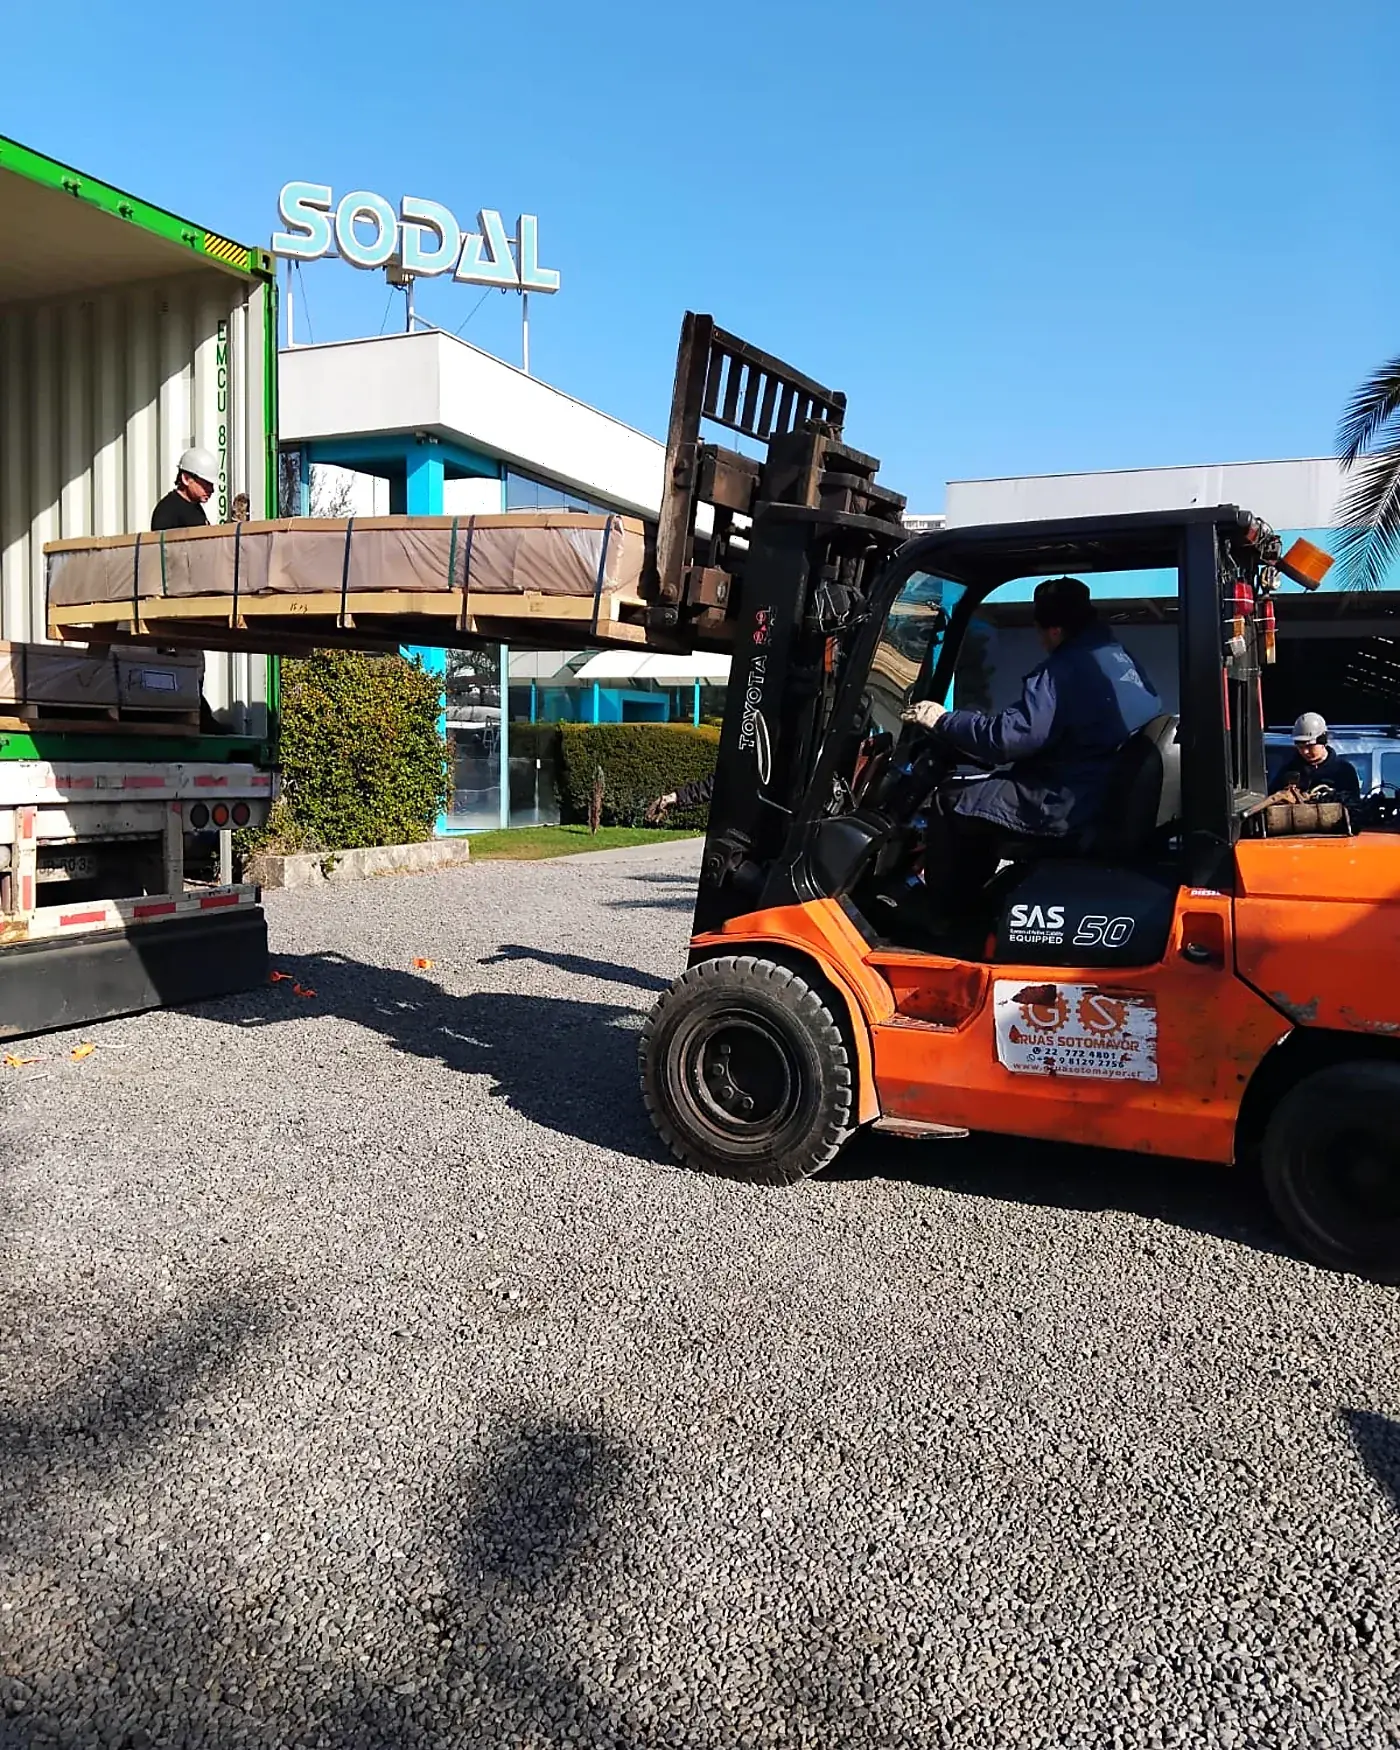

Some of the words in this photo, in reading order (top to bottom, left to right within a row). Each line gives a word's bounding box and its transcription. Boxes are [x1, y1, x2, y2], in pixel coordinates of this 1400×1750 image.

[271, 180, 560, 294] SODAL
[216, 319, 227, 412] EMCU
[738, 655, 767, 750] TOYOTA
[1010, 904, 1065, 929] SAS
[1009, 934, 1064, 945] EQUIPPED
[1072, 915, 1135, 947] 50
[1044, 1048, 1058, 1056] 22
[1064, 1049, 1085, 1058] 772
[1057, 1036, 1140, 1052] SOTOMAYOR
